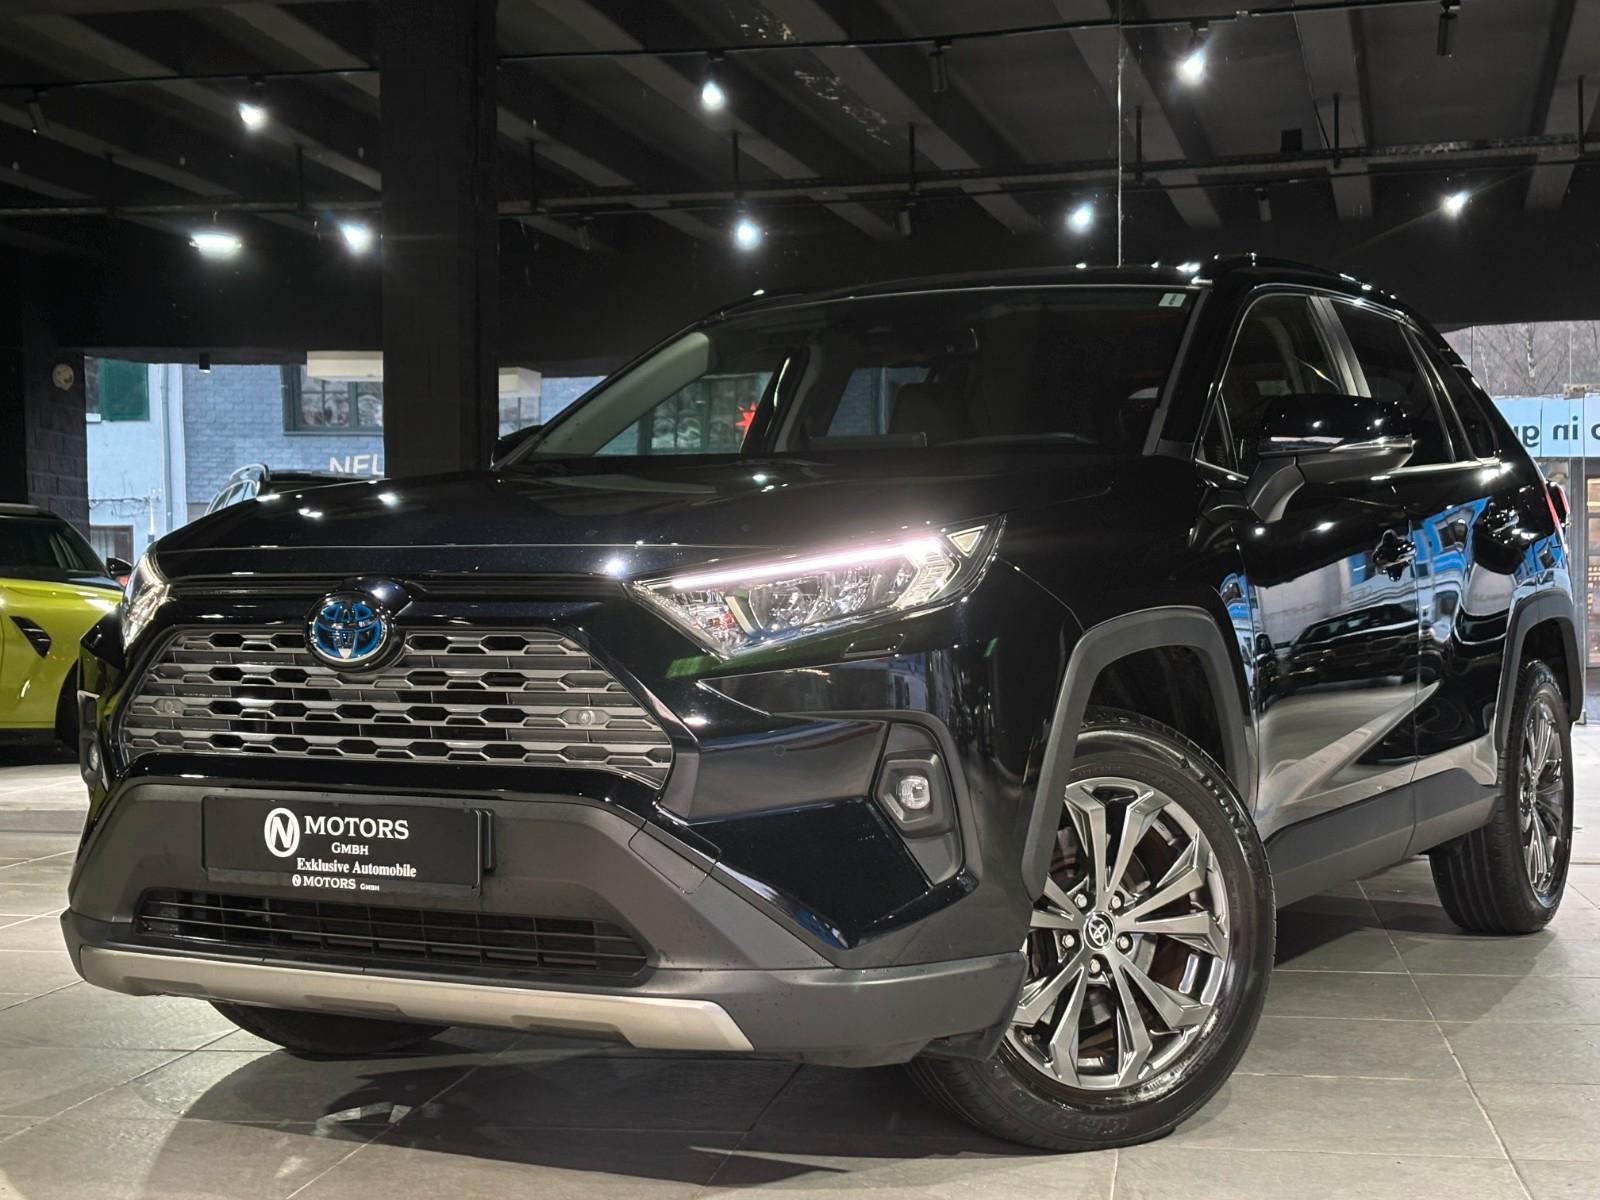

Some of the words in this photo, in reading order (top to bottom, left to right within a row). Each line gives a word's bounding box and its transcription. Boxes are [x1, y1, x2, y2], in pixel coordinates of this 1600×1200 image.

[303, 815, 409, 840] MOTORS
[331, 841, 369, 855] GMBH
[296, 857, 350, 873] Exklusive
[352, 860, 417, 878] Automobile
[303, 875, 356, 890] MOTORS
